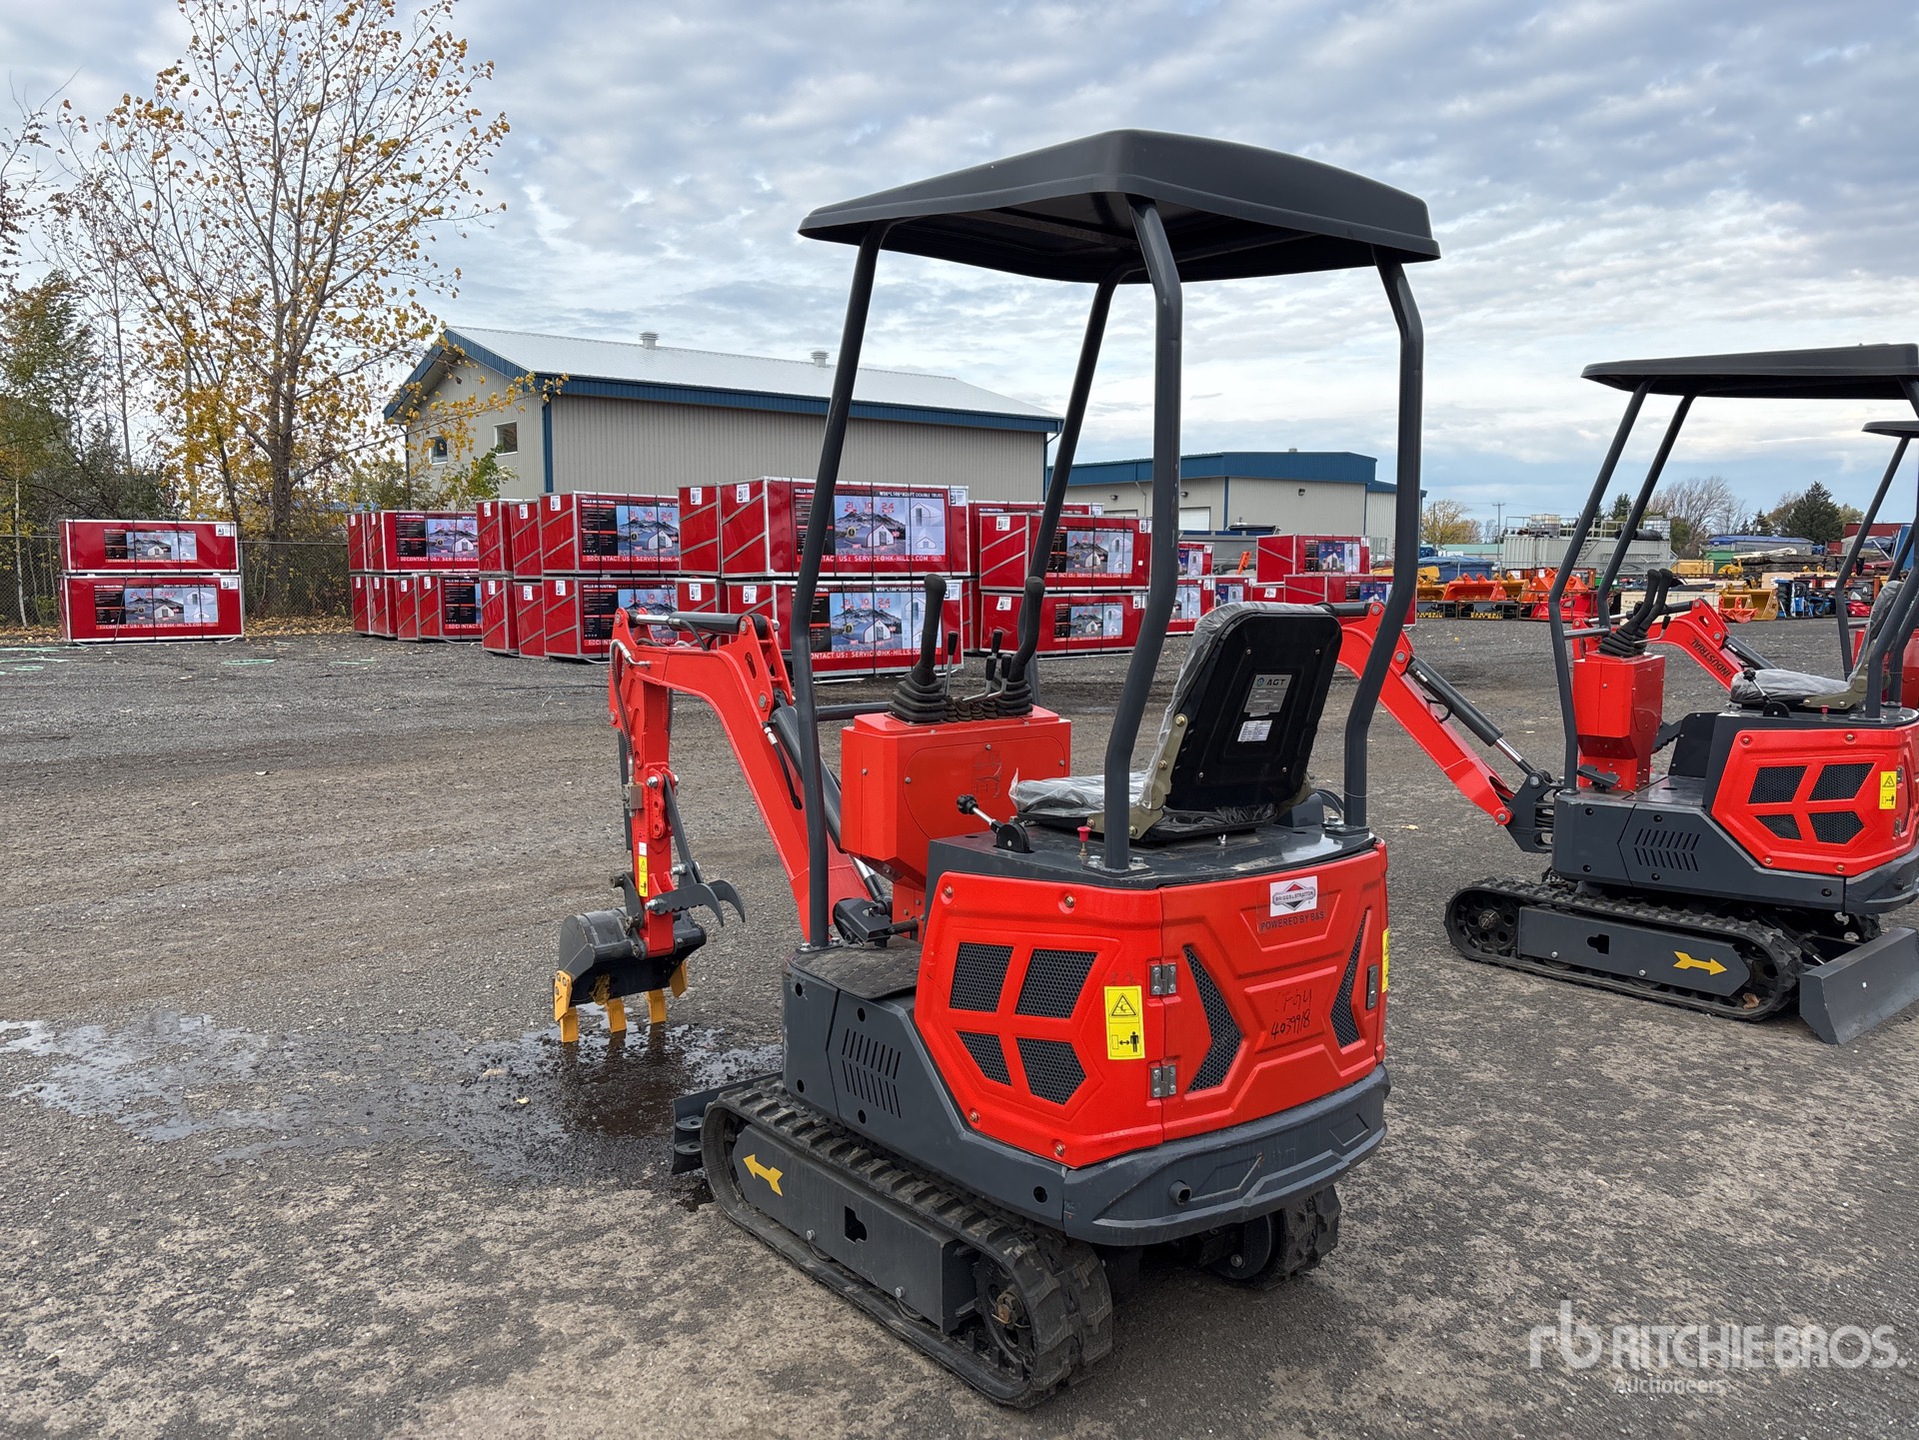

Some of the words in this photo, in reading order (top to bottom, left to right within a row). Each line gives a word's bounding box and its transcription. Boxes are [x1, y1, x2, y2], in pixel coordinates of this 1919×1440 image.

[1691, 639, 1732, 678] INDUSTRIAL
[1260, 915, 1299, 931] POWERED
[1299, 913, 1310, 924] BY
[1310, 910, 1325, 922] B&S
